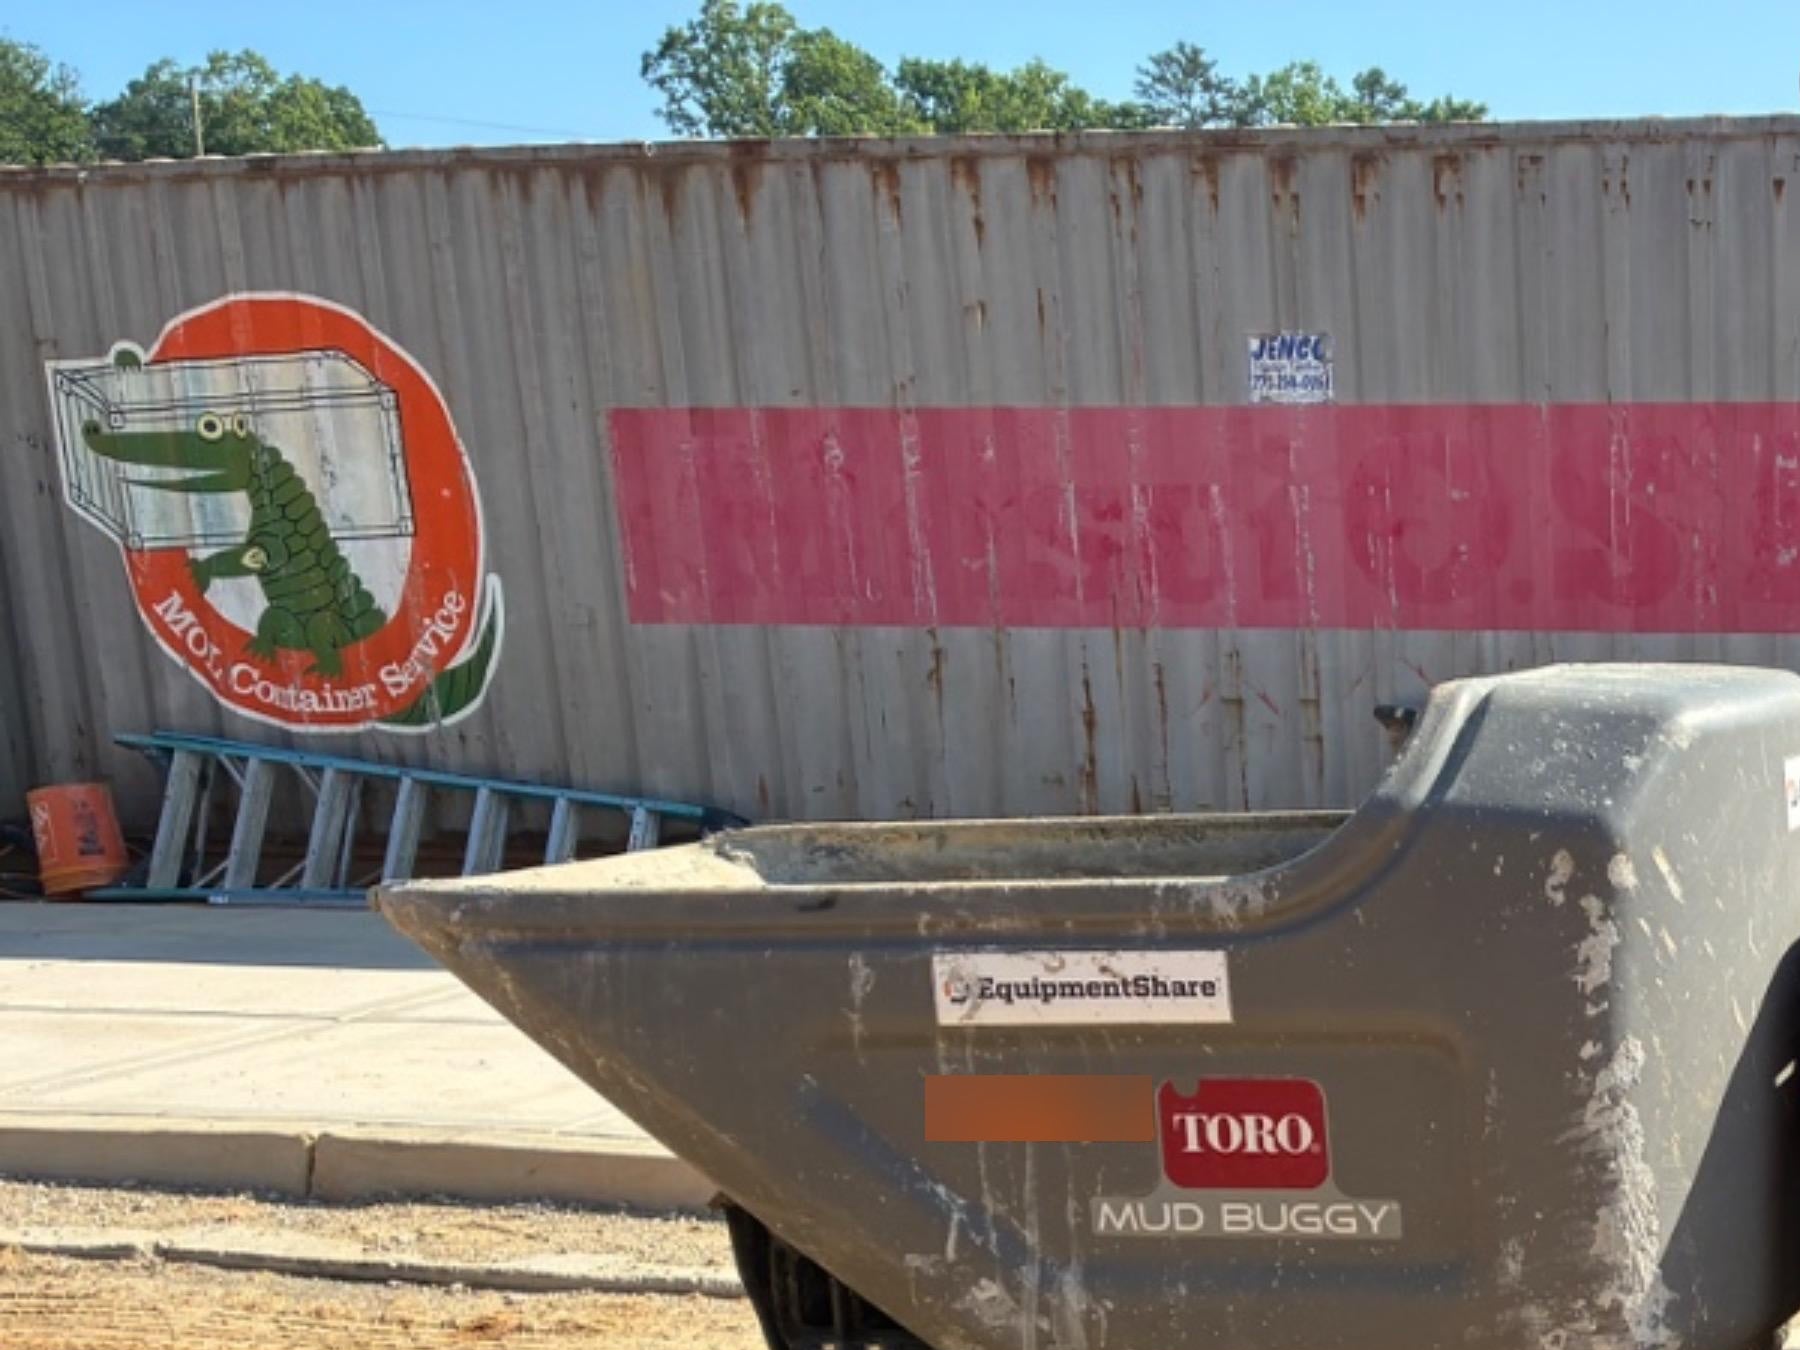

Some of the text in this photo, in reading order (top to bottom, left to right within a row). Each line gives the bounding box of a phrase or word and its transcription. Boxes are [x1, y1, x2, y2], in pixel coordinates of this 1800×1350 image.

[977, 975, 1217, 1005] EquipmentShare
[1172, 1112, 1314, 1154] TORO
[1099, 1202, 1391, 1234] MUD BUGGY
